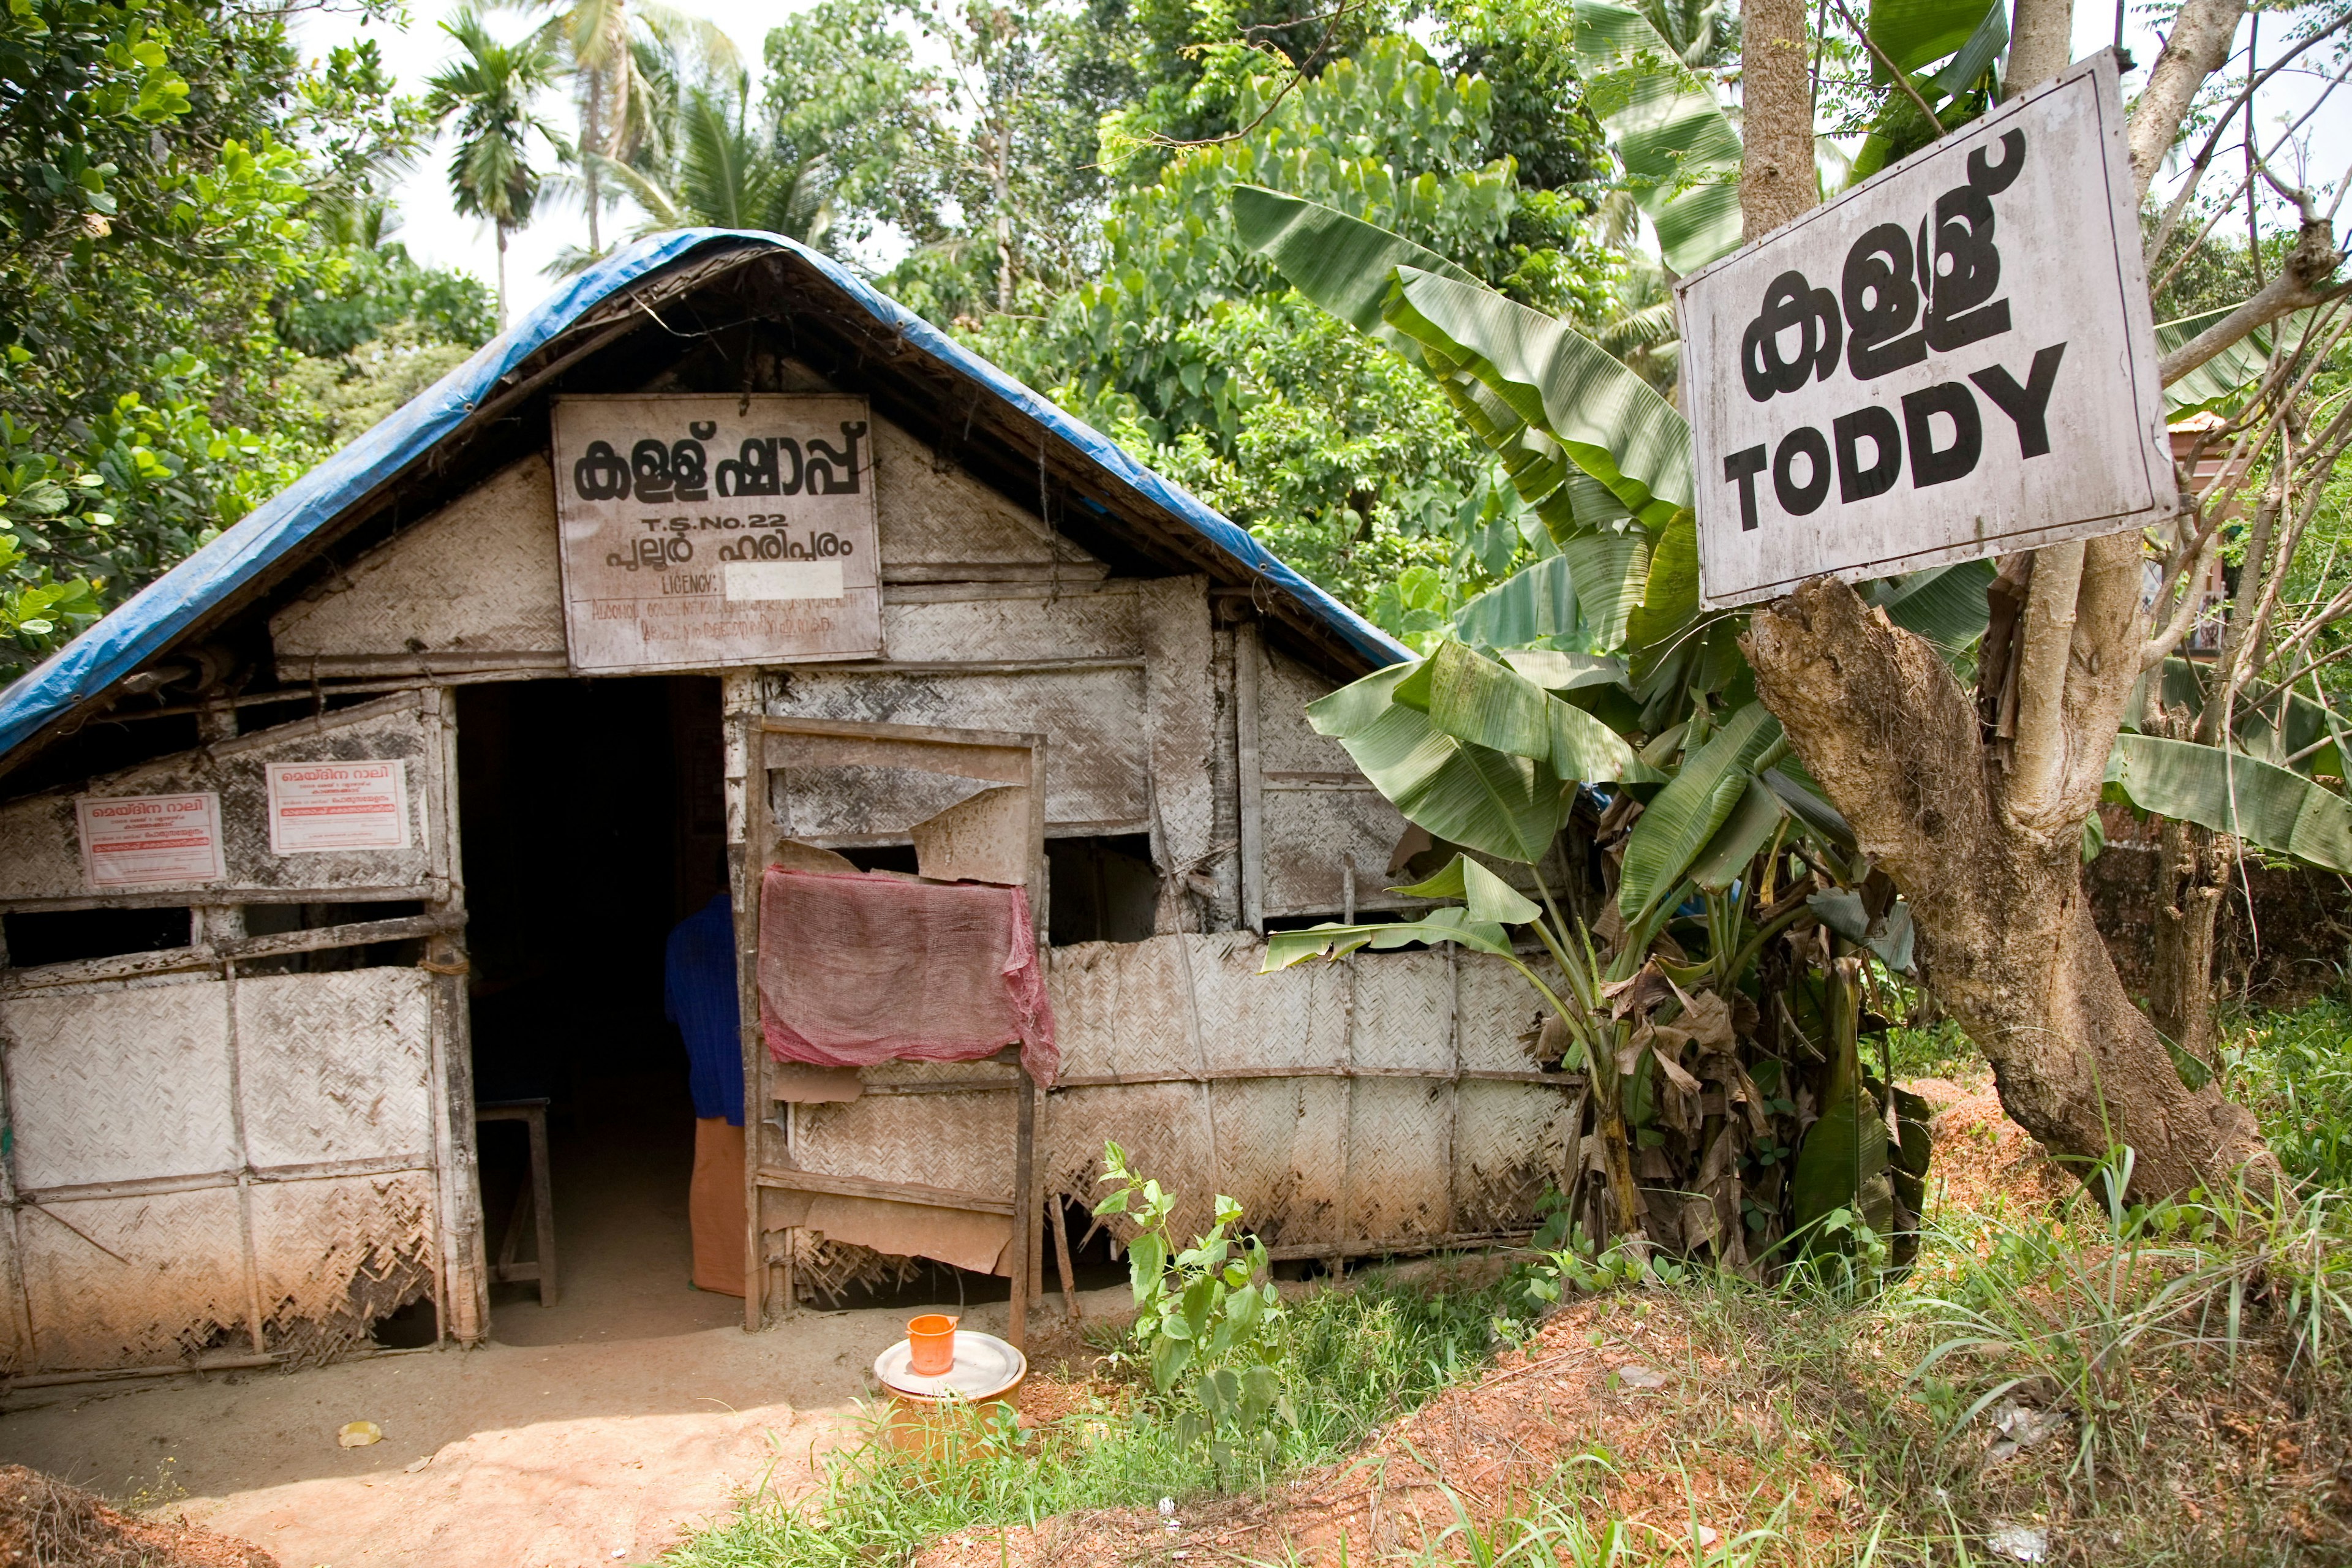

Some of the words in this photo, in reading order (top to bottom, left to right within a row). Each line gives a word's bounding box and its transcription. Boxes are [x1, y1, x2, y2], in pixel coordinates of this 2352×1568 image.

[1741, 127, 2026, 402] കള്ള്
[1724, 341, 2068, 532] TODDY
[92, 803, 162, 818] മെയ്ദിന
[166, 799, 203, 813] റാലി
[282, 768, 348, 782] മെയ്ദിന
[353, 766, 389, 778] റാലി
